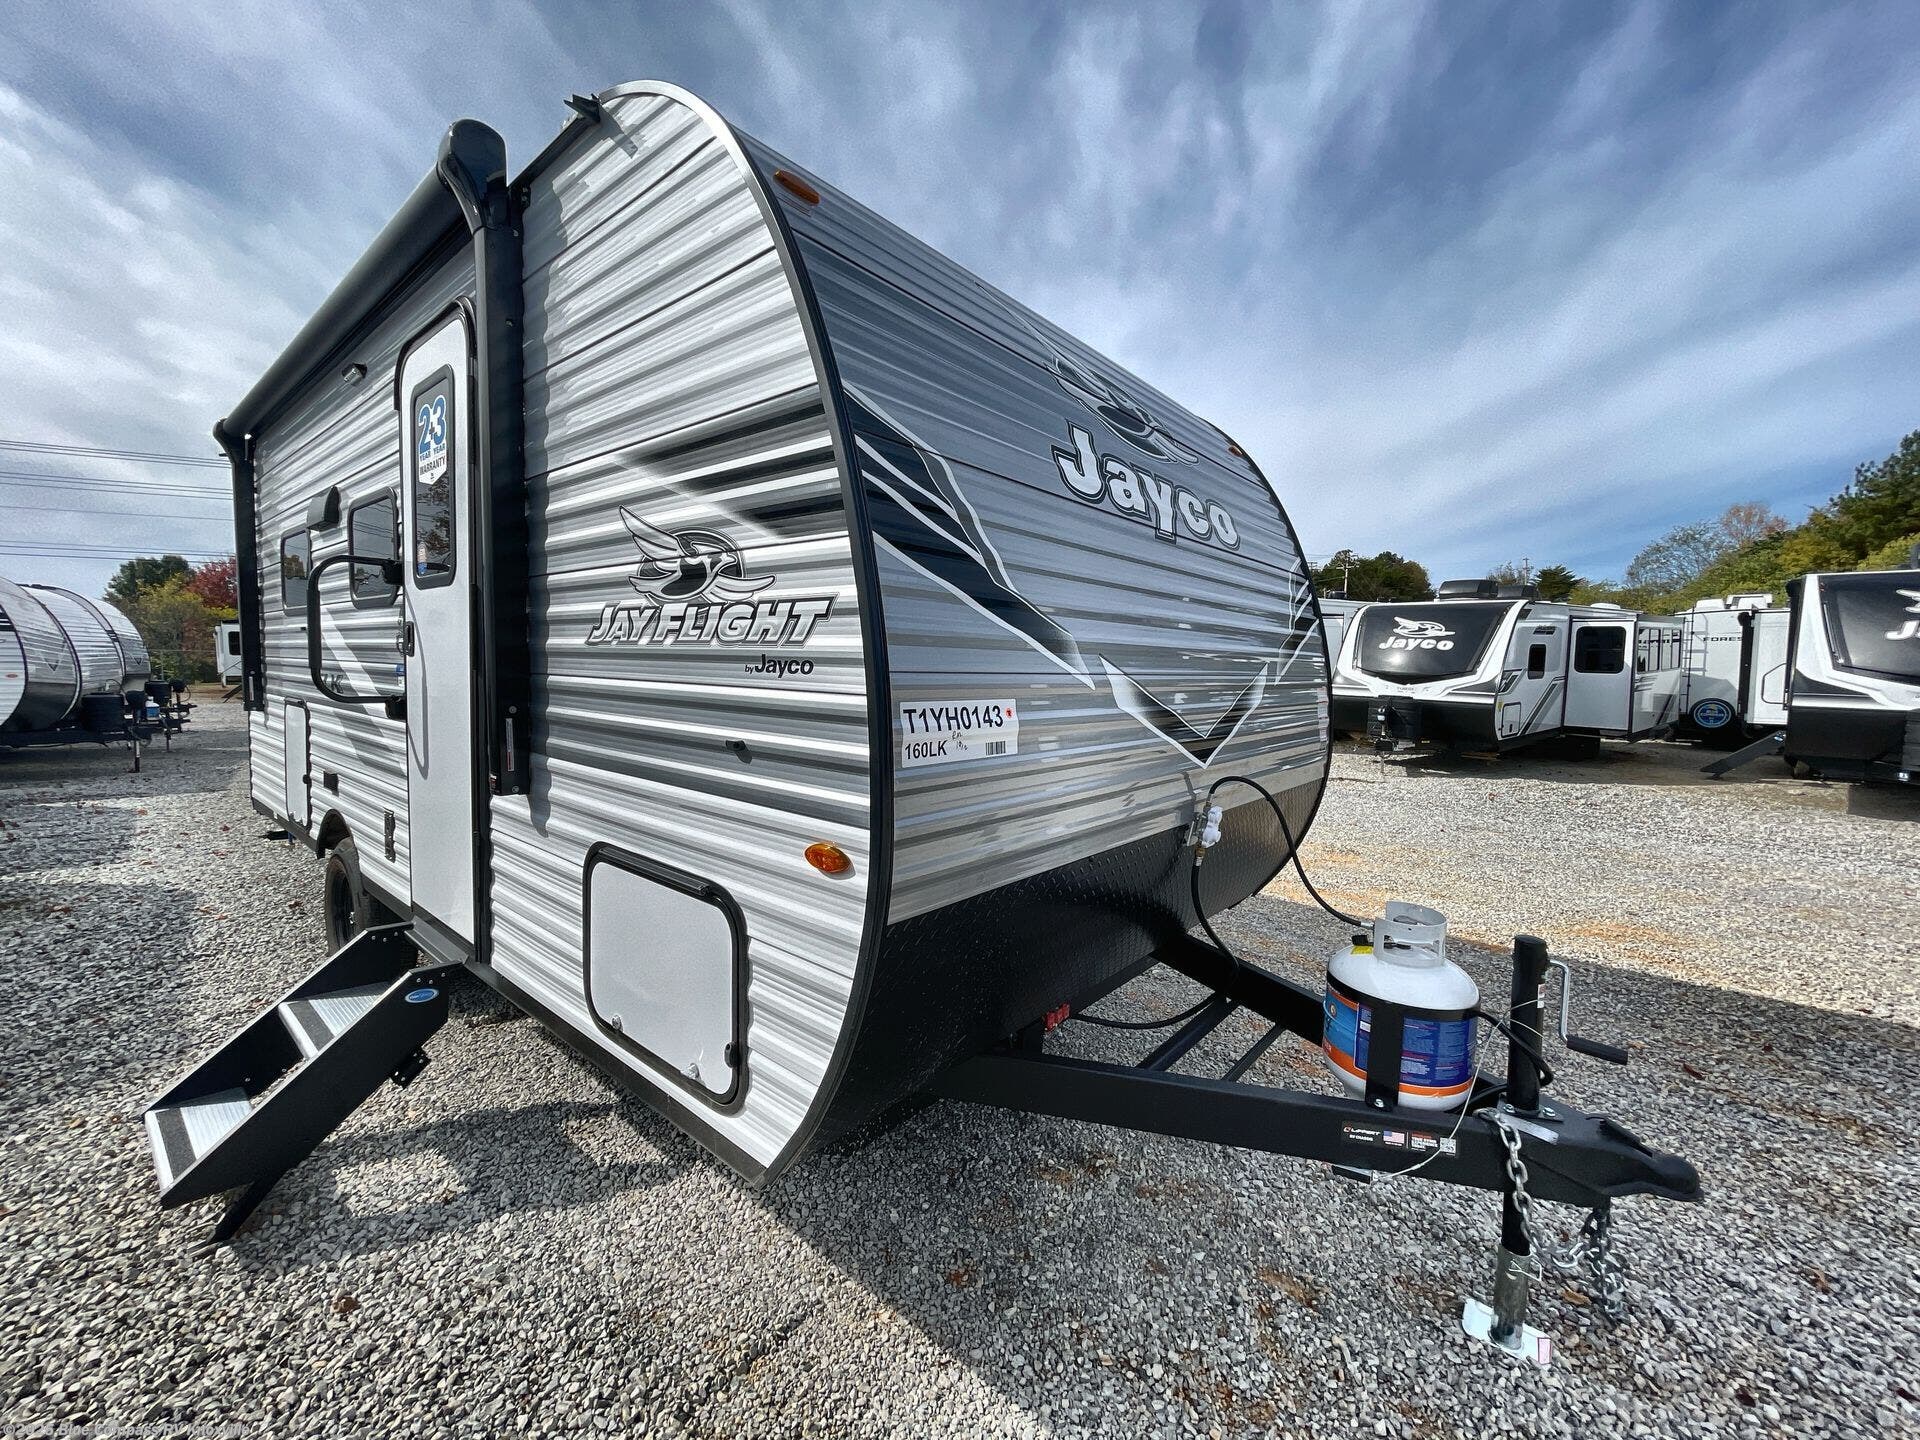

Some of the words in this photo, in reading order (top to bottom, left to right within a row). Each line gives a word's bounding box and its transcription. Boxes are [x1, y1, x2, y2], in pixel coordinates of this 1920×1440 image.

[419, 455, 446, 476] WARRANTY
[1050, 420, 1241, 551] Jayco
[1378, 636, 1455, 651] Jayco
[754, 653, 814, 679] Jayco
[902, 705, 1004, 734] T1YH0143
[905, 740, 948, 760] 160LK
